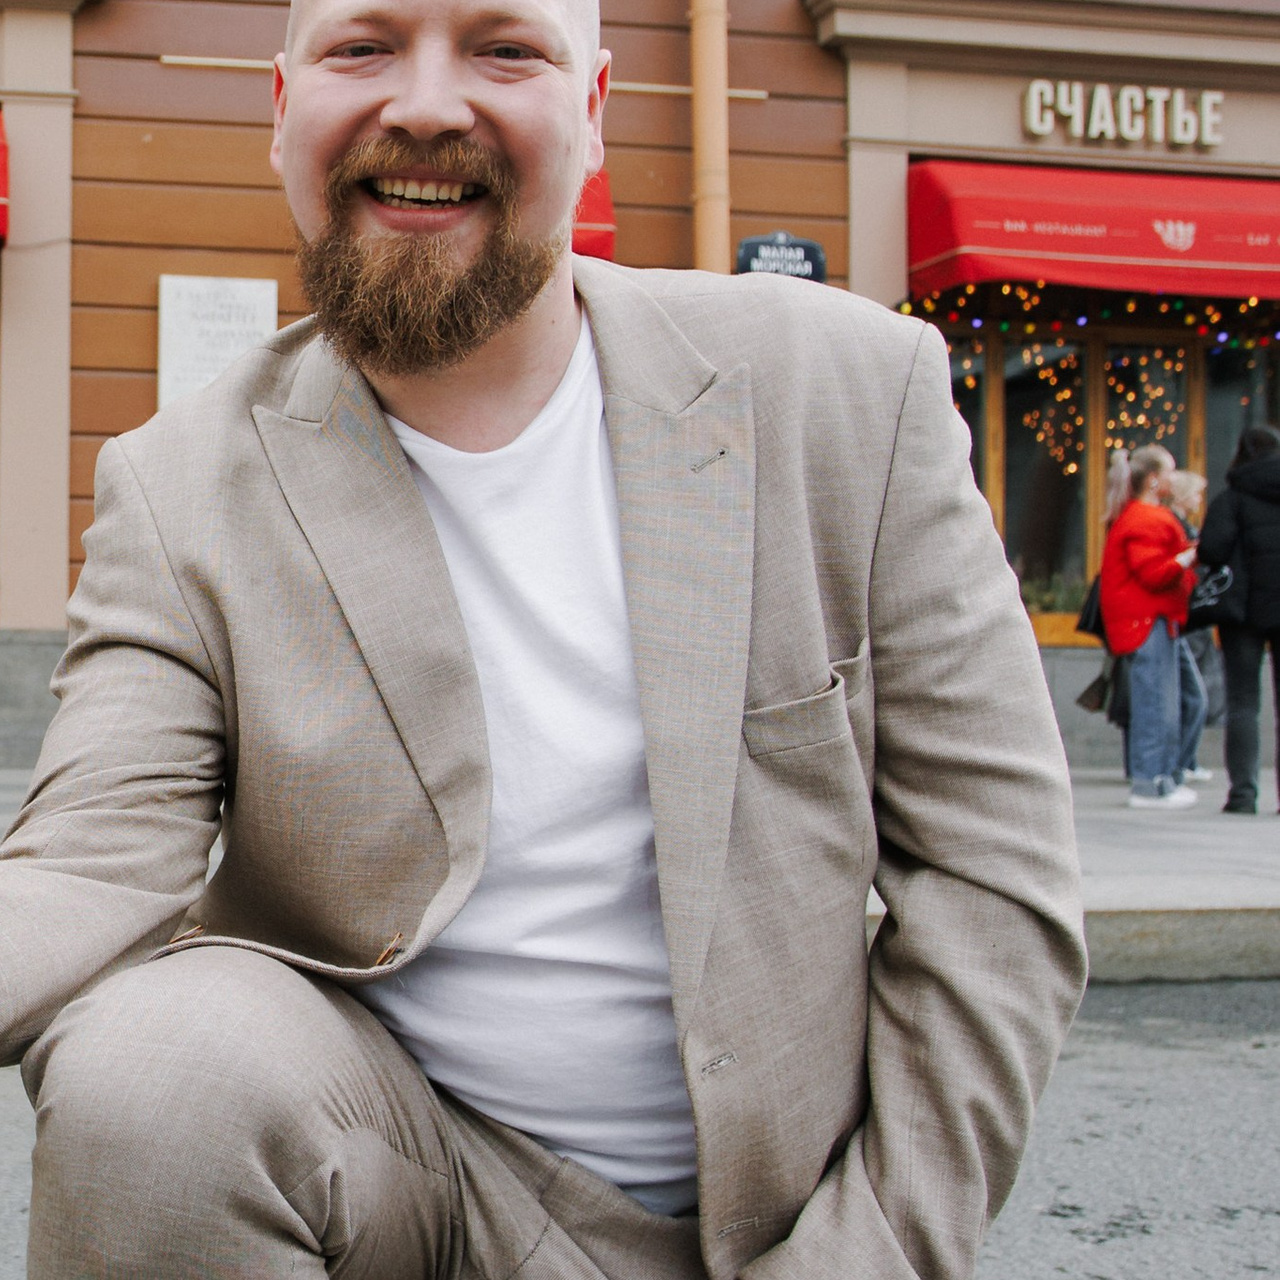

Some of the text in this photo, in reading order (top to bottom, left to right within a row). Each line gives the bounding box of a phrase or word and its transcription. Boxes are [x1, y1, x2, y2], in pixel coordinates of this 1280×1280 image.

[1026, 78, 1224, 145] СЧАСТЬЕ
[758, 245, 805, 262] МАЛАЯ
[750, 257, 813, 277] МОРСКАЯ
